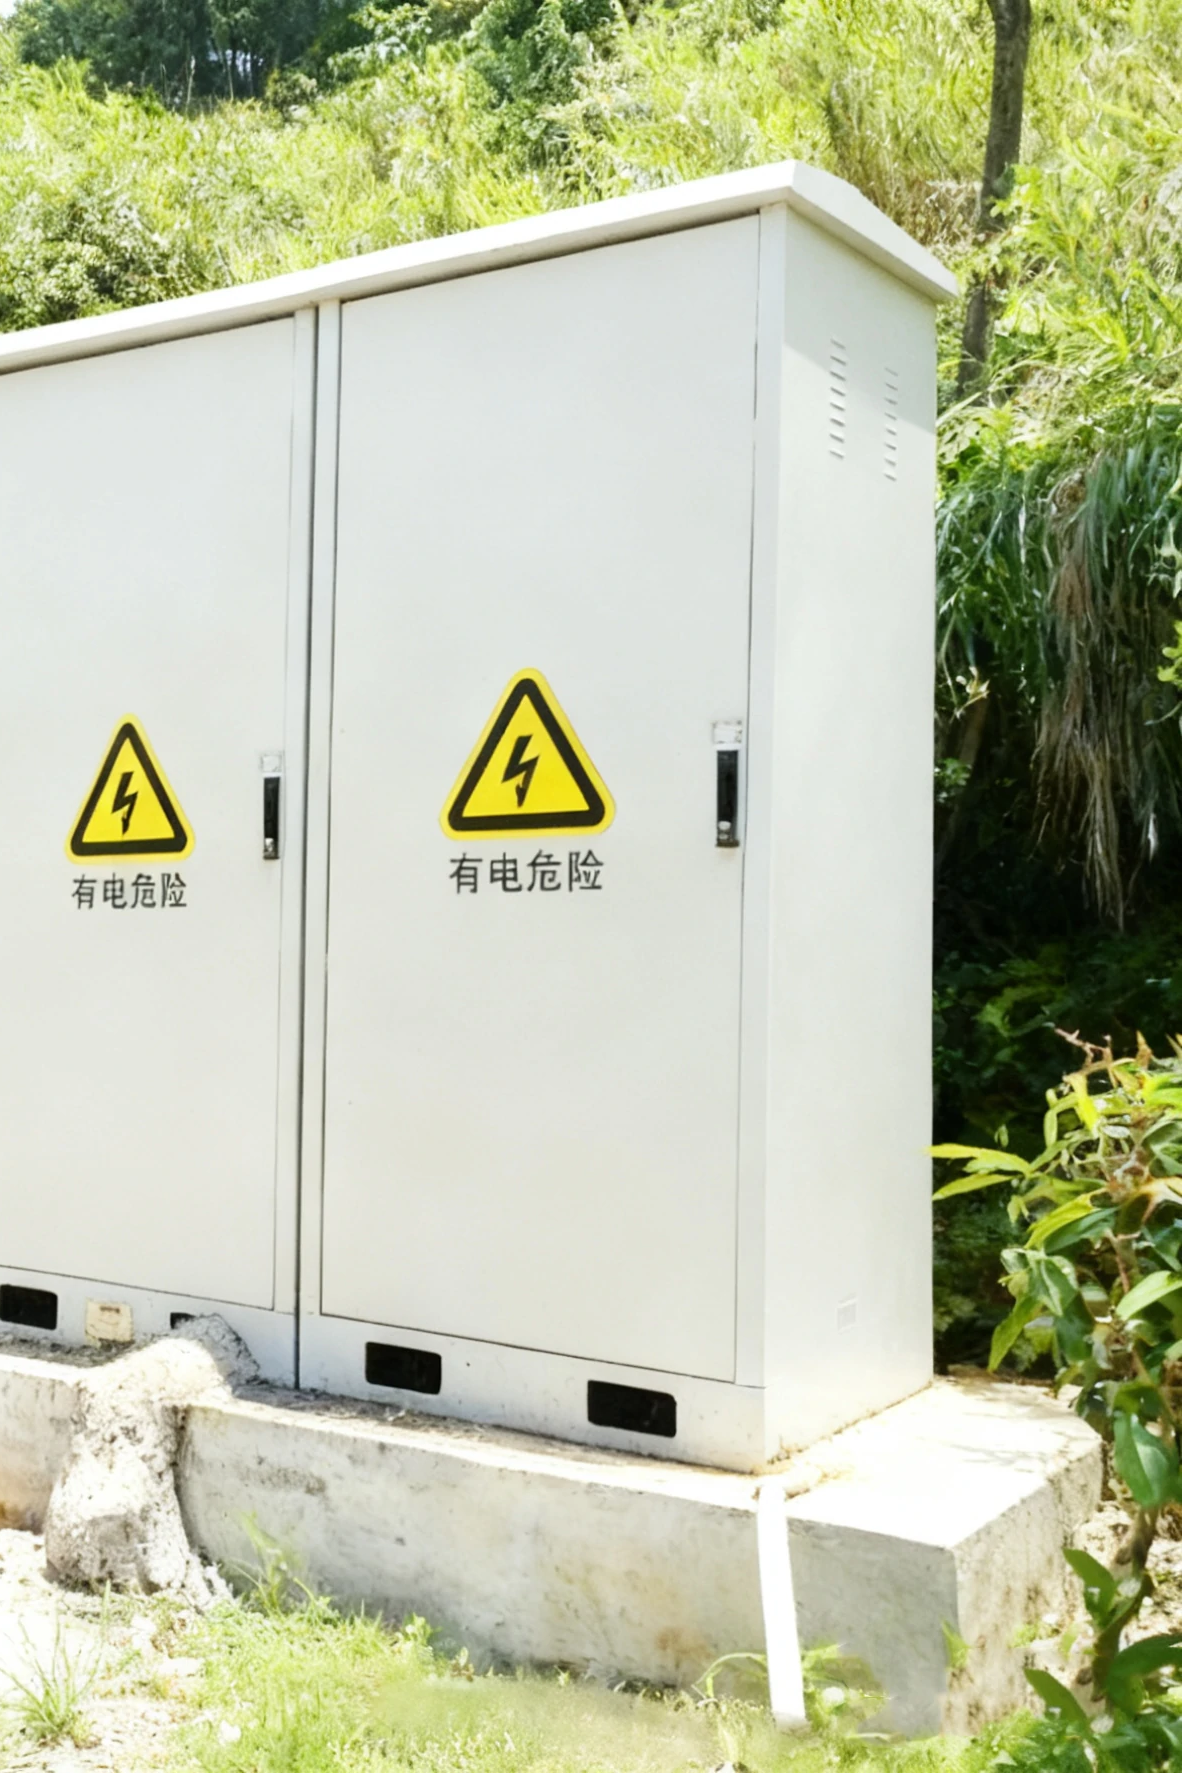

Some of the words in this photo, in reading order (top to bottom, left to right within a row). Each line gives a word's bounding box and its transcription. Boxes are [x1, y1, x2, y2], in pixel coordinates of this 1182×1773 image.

[71, 872, 188, 910] 有电危险
[449, 849, 605, 894] 有电危险
